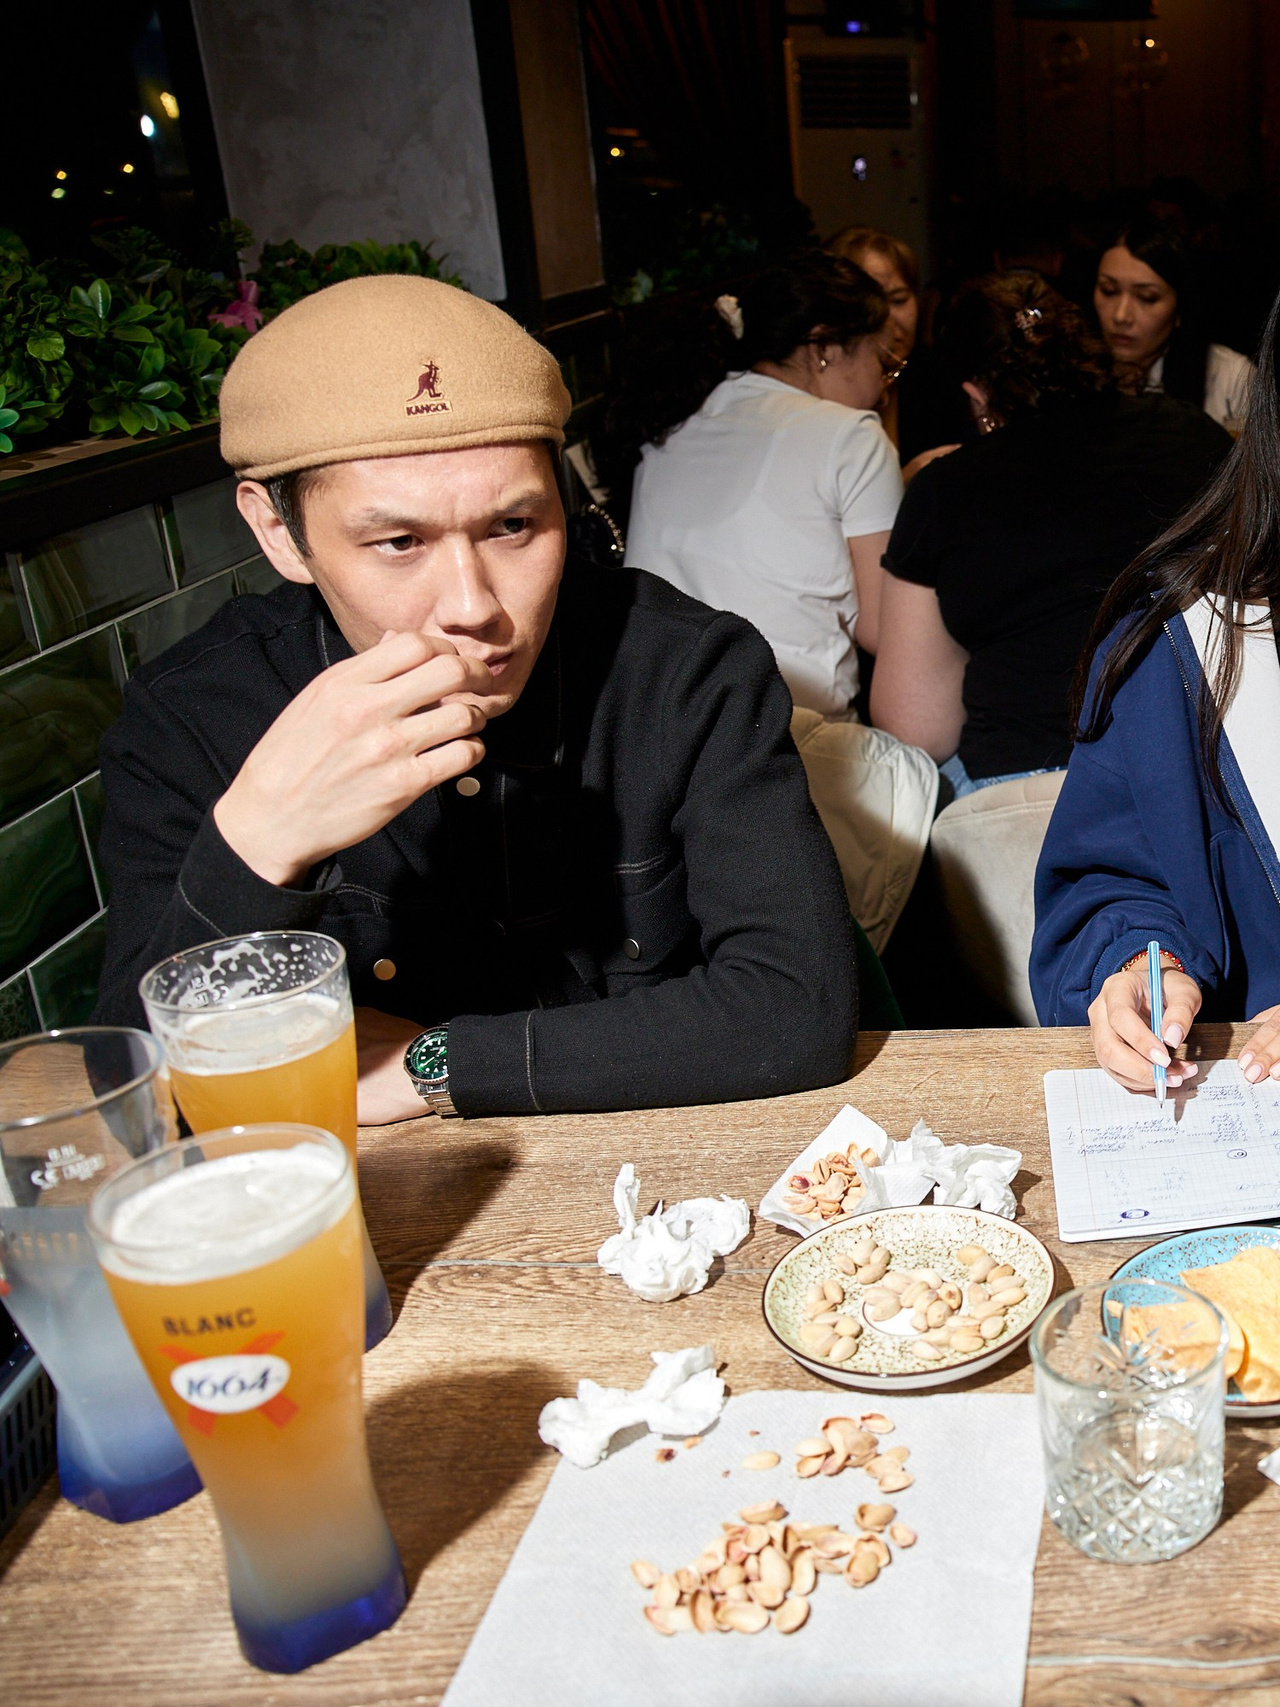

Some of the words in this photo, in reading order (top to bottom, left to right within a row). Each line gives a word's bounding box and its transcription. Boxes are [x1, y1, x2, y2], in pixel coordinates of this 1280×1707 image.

[406, 403, 449, 416] KANGOL
[163, 1307, 256, 1336] BLANC
[187, 1366, 271, 1399] 1664
